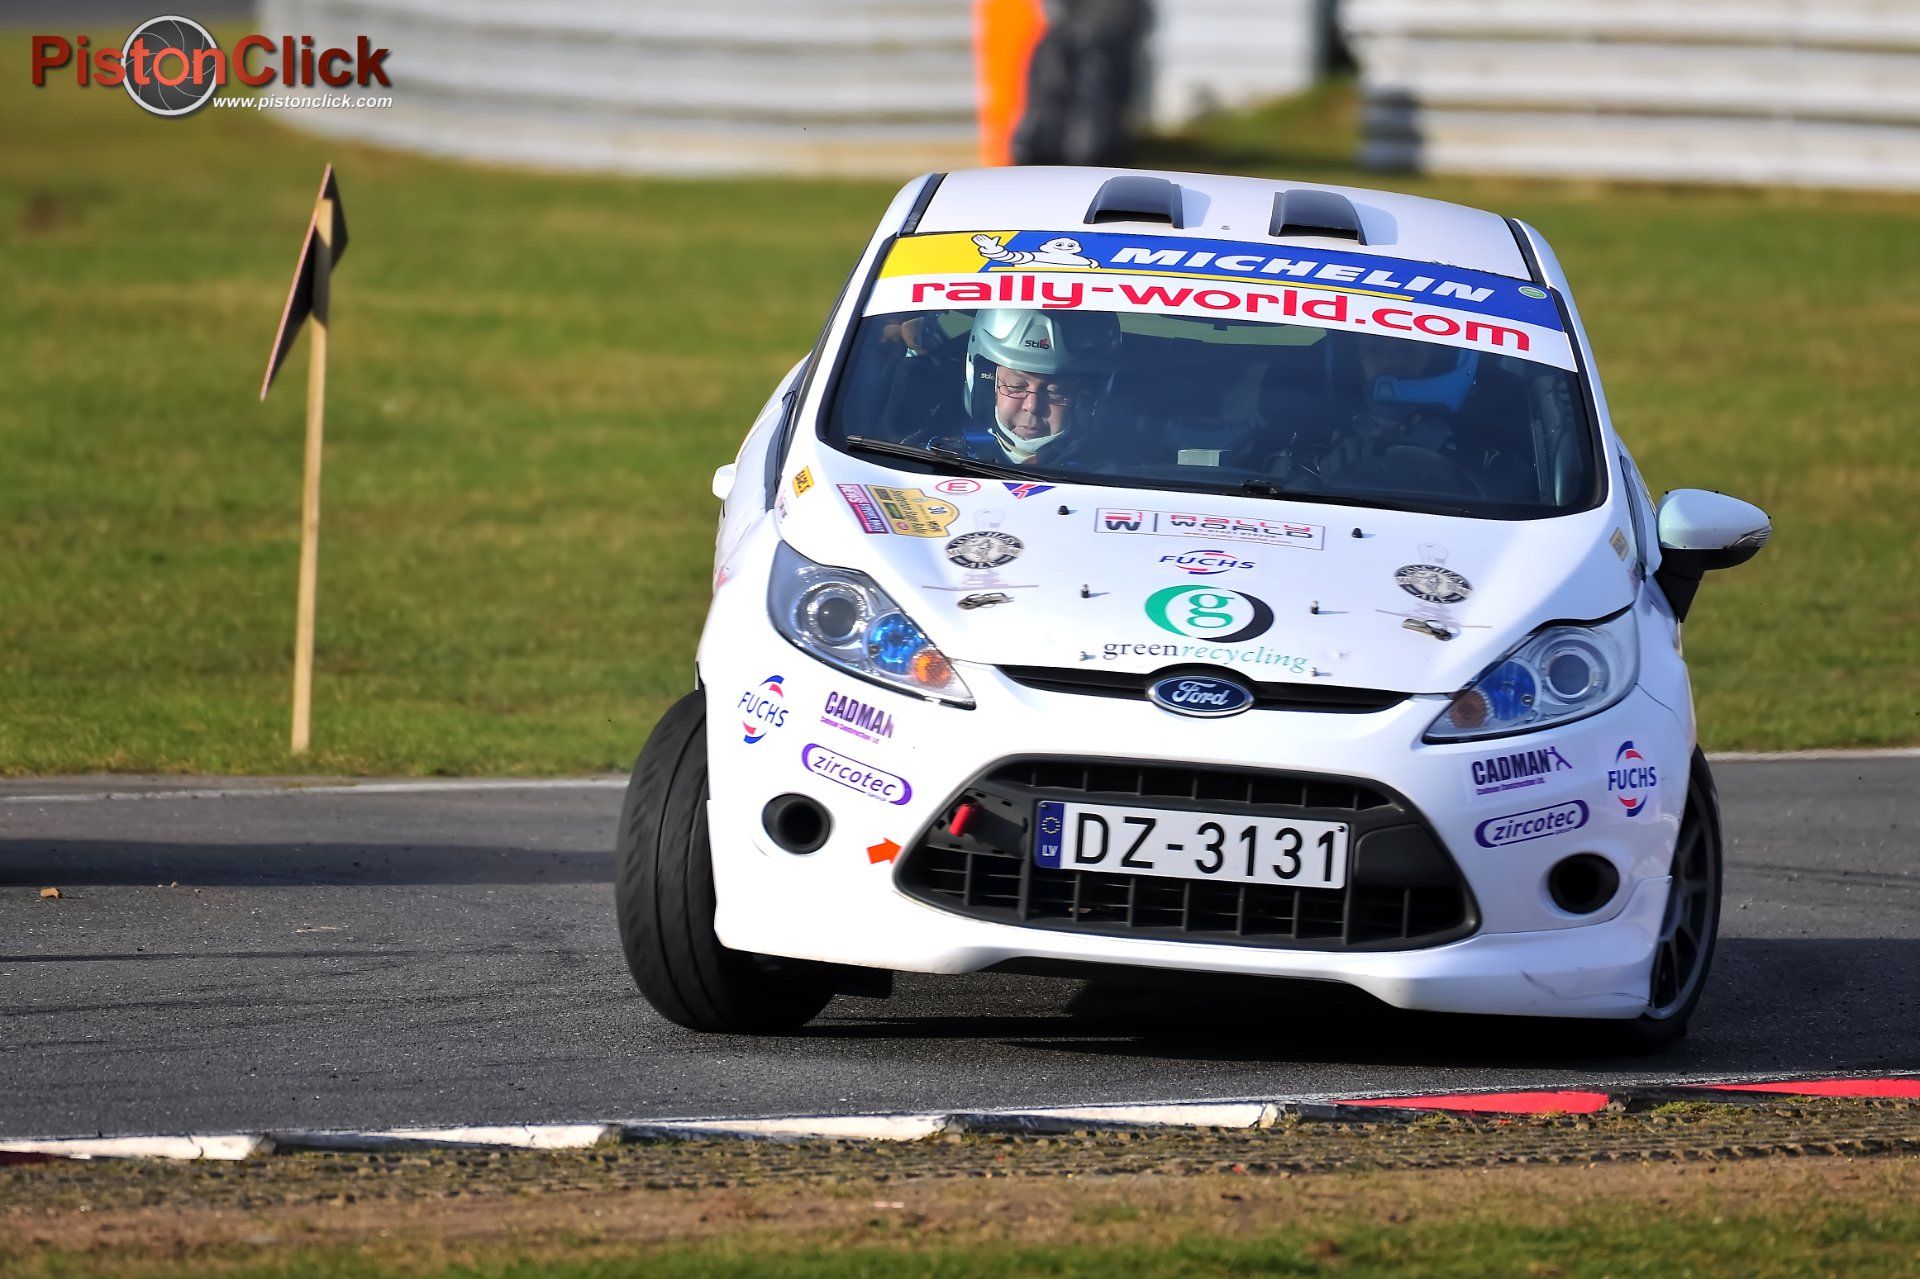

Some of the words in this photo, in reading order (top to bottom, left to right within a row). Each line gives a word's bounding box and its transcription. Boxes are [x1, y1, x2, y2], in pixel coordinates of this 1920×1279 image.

[1110, 247, 1495, 302] MICHELIN
[912, 275, 1530, 351] rally-world.com
[1158, 554, 1256, 569] FUCHS
[738, 691, 789, 727] FUCHS
[1171, 680, 1229, 705] Ford
[824, 691, 895, 738] CADMAN
[813, 755, 897, 796] zircotec
[1471, 748, 1551, 786] CADMAN
[1607, 766, 1657, 791] FUCHS
[1492, 807, 1576, 841] zircotec
[1041, 844, 1058, 857] LV
[1075, 812, 1335, 882] DZ-3131
